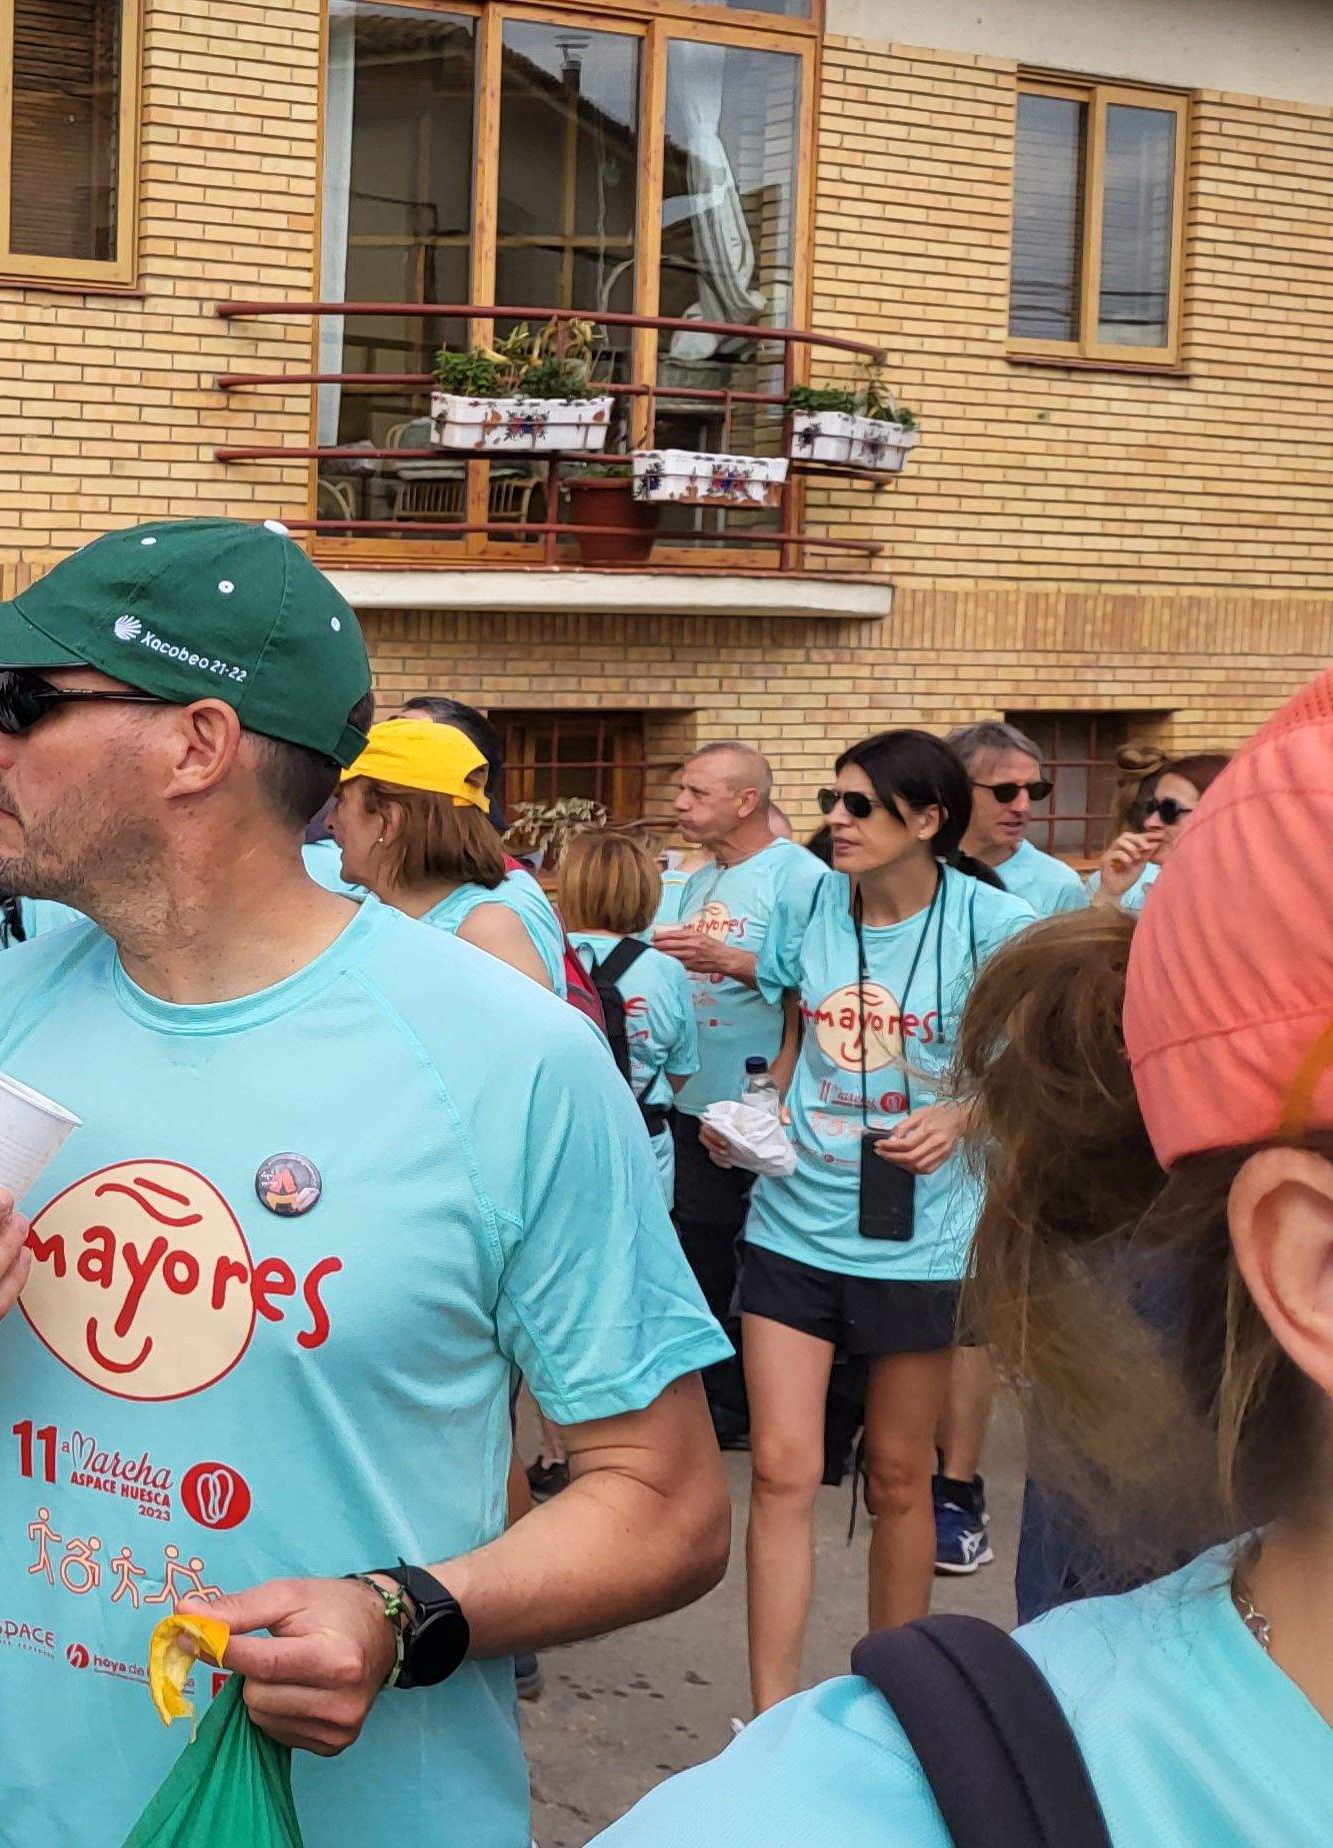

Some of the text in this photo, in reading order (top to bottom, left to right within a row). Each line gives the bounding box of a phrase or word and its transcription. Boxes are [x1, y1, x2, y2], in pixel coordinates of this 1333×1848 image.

[141, 630, 209, 670] Xacobeo
[23, 1224, 343, 1350] mayores
[71, 1431, 174, 1491] Marcha
[70, 1471, 172, 1509] ASPACE HUESCA
[138, 1503, 171, 1522] 2023
